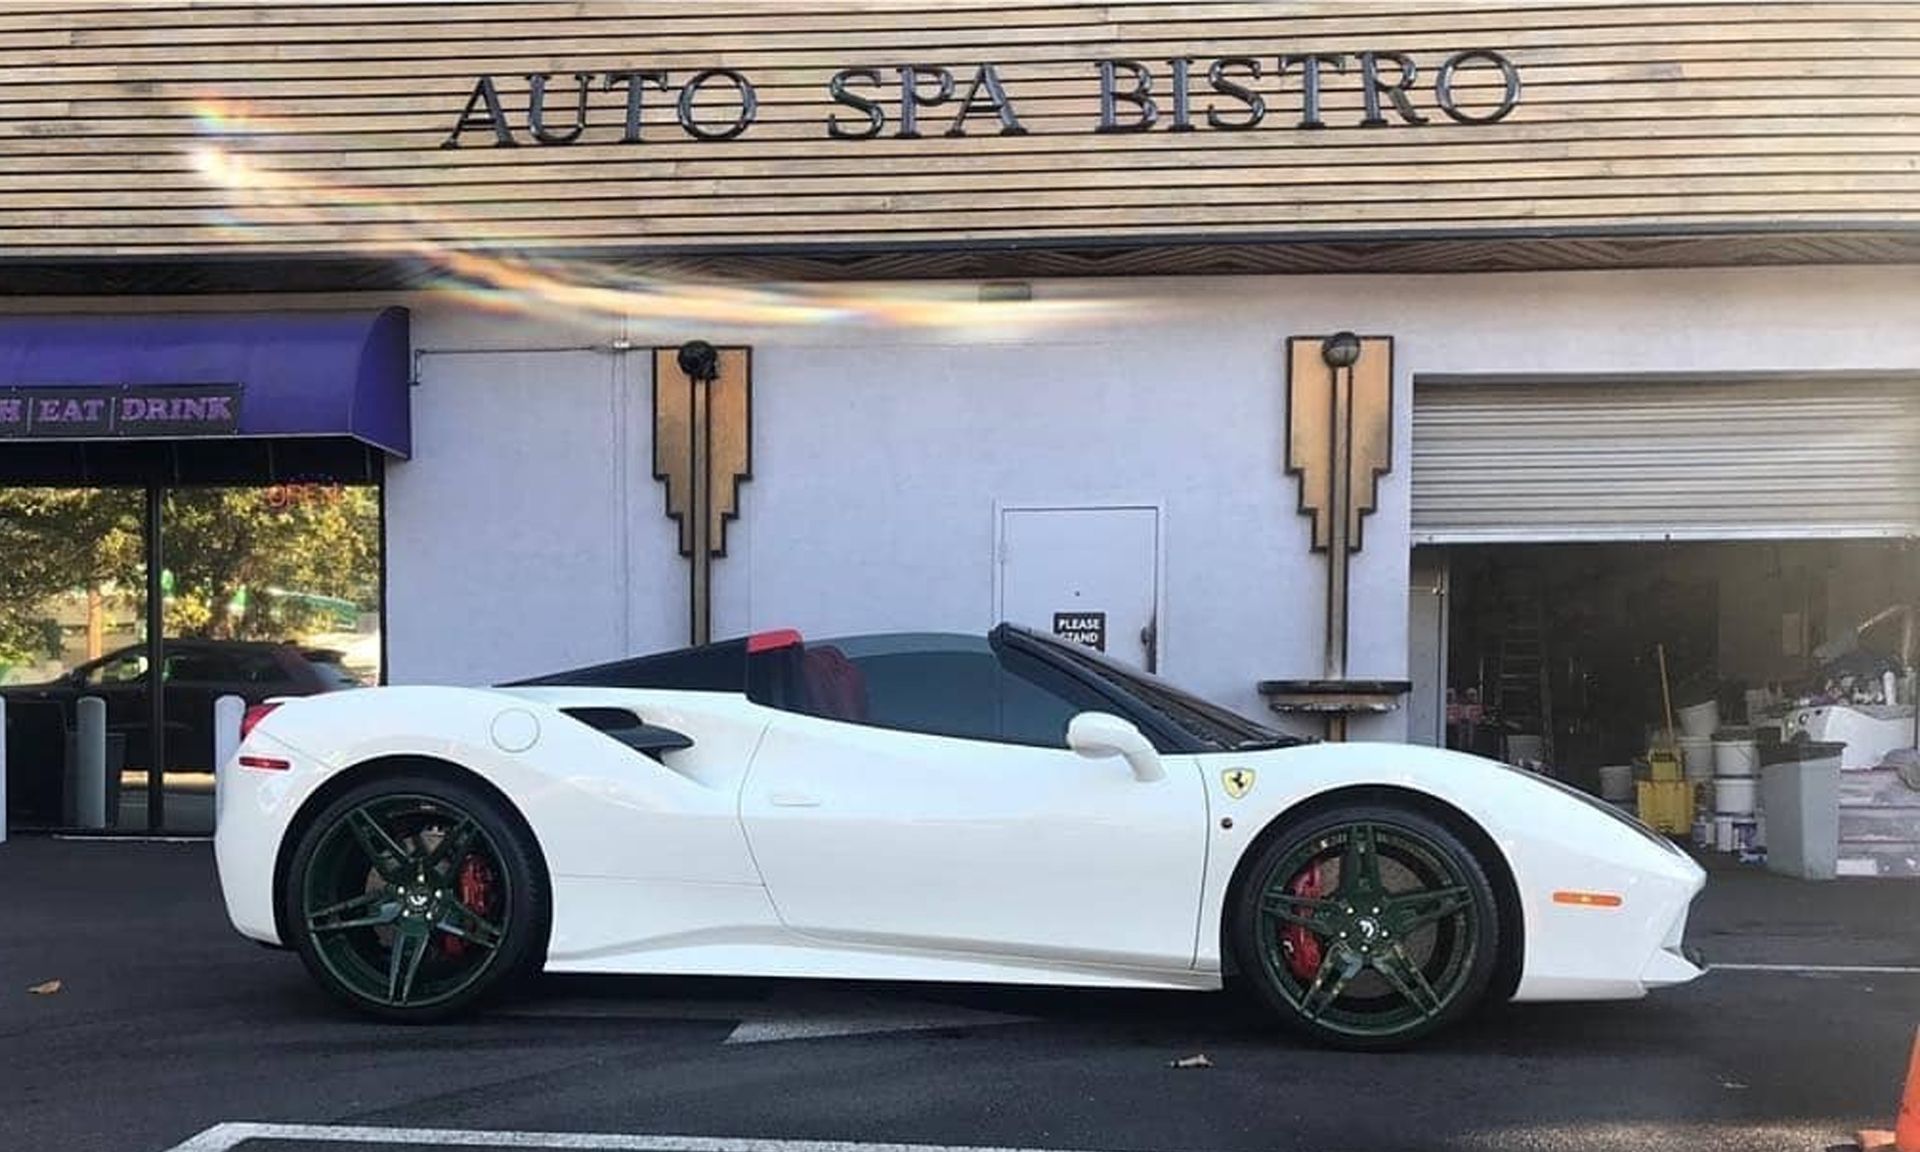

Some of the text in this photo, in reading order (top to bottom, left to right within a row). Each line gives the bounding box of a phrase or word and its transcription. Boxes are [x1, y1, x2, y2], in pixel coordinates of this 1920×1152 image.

[440, 49, 1521, 149] AUTO SPA BISTRO
[39, 399, 104, 421] EAT
[121, 396, 233, 421] DRINK
[1059, 618, 1102, 630] PLEASE
